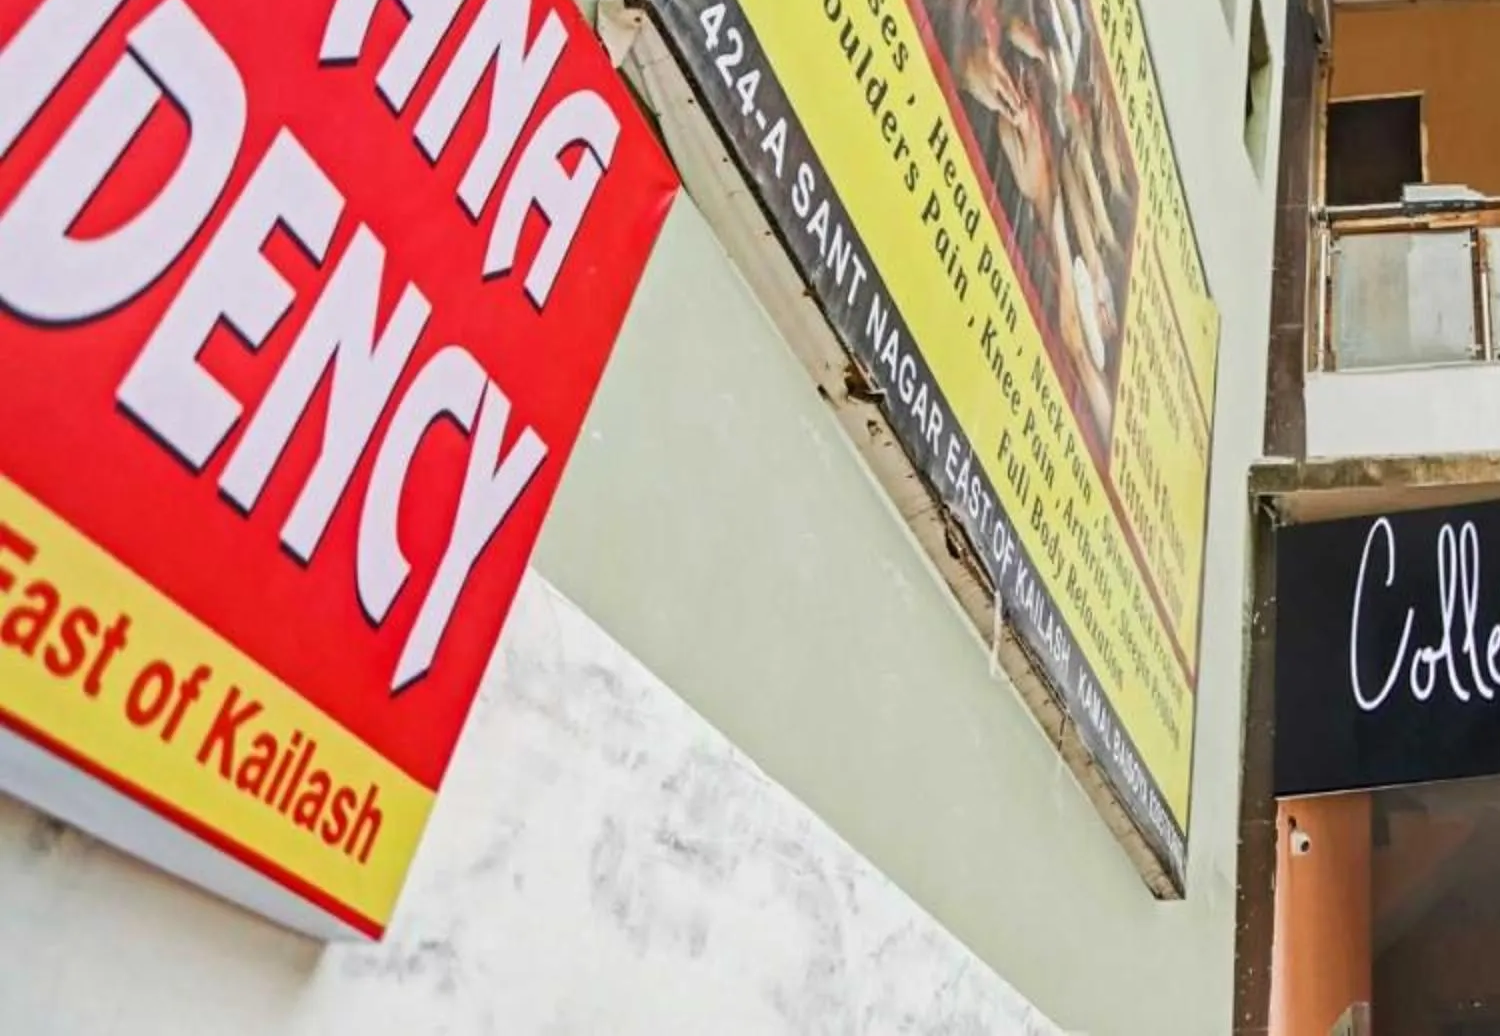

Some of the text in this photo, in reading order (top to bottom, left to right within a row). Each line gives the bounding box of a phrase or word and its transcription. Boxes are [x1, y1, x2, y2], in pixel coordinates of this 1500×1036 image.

[699, 2, 786, 177] 424-A
[790, 162, 867, 306] SANT
[865, 306, 945, 446] NAGAR
[943, 434, 993, 535] EAST
[992, 520, 1015, 577] OF
[922, 193, 970, 304] Pain
[979, 317, 1022, 417] Knee
[1021, 410, 1056, 489] Pain
[927, 116, 980, 240] Head
[977, 247, 1019, 335] pain
[1030, 350, 1063, 435] Neck
[997, 431, 1030, 508] Full
[1029, 507, 1066, 582] Body
[124, 658, 212, 743] of
[196, 685, 384, 865] Kailash
